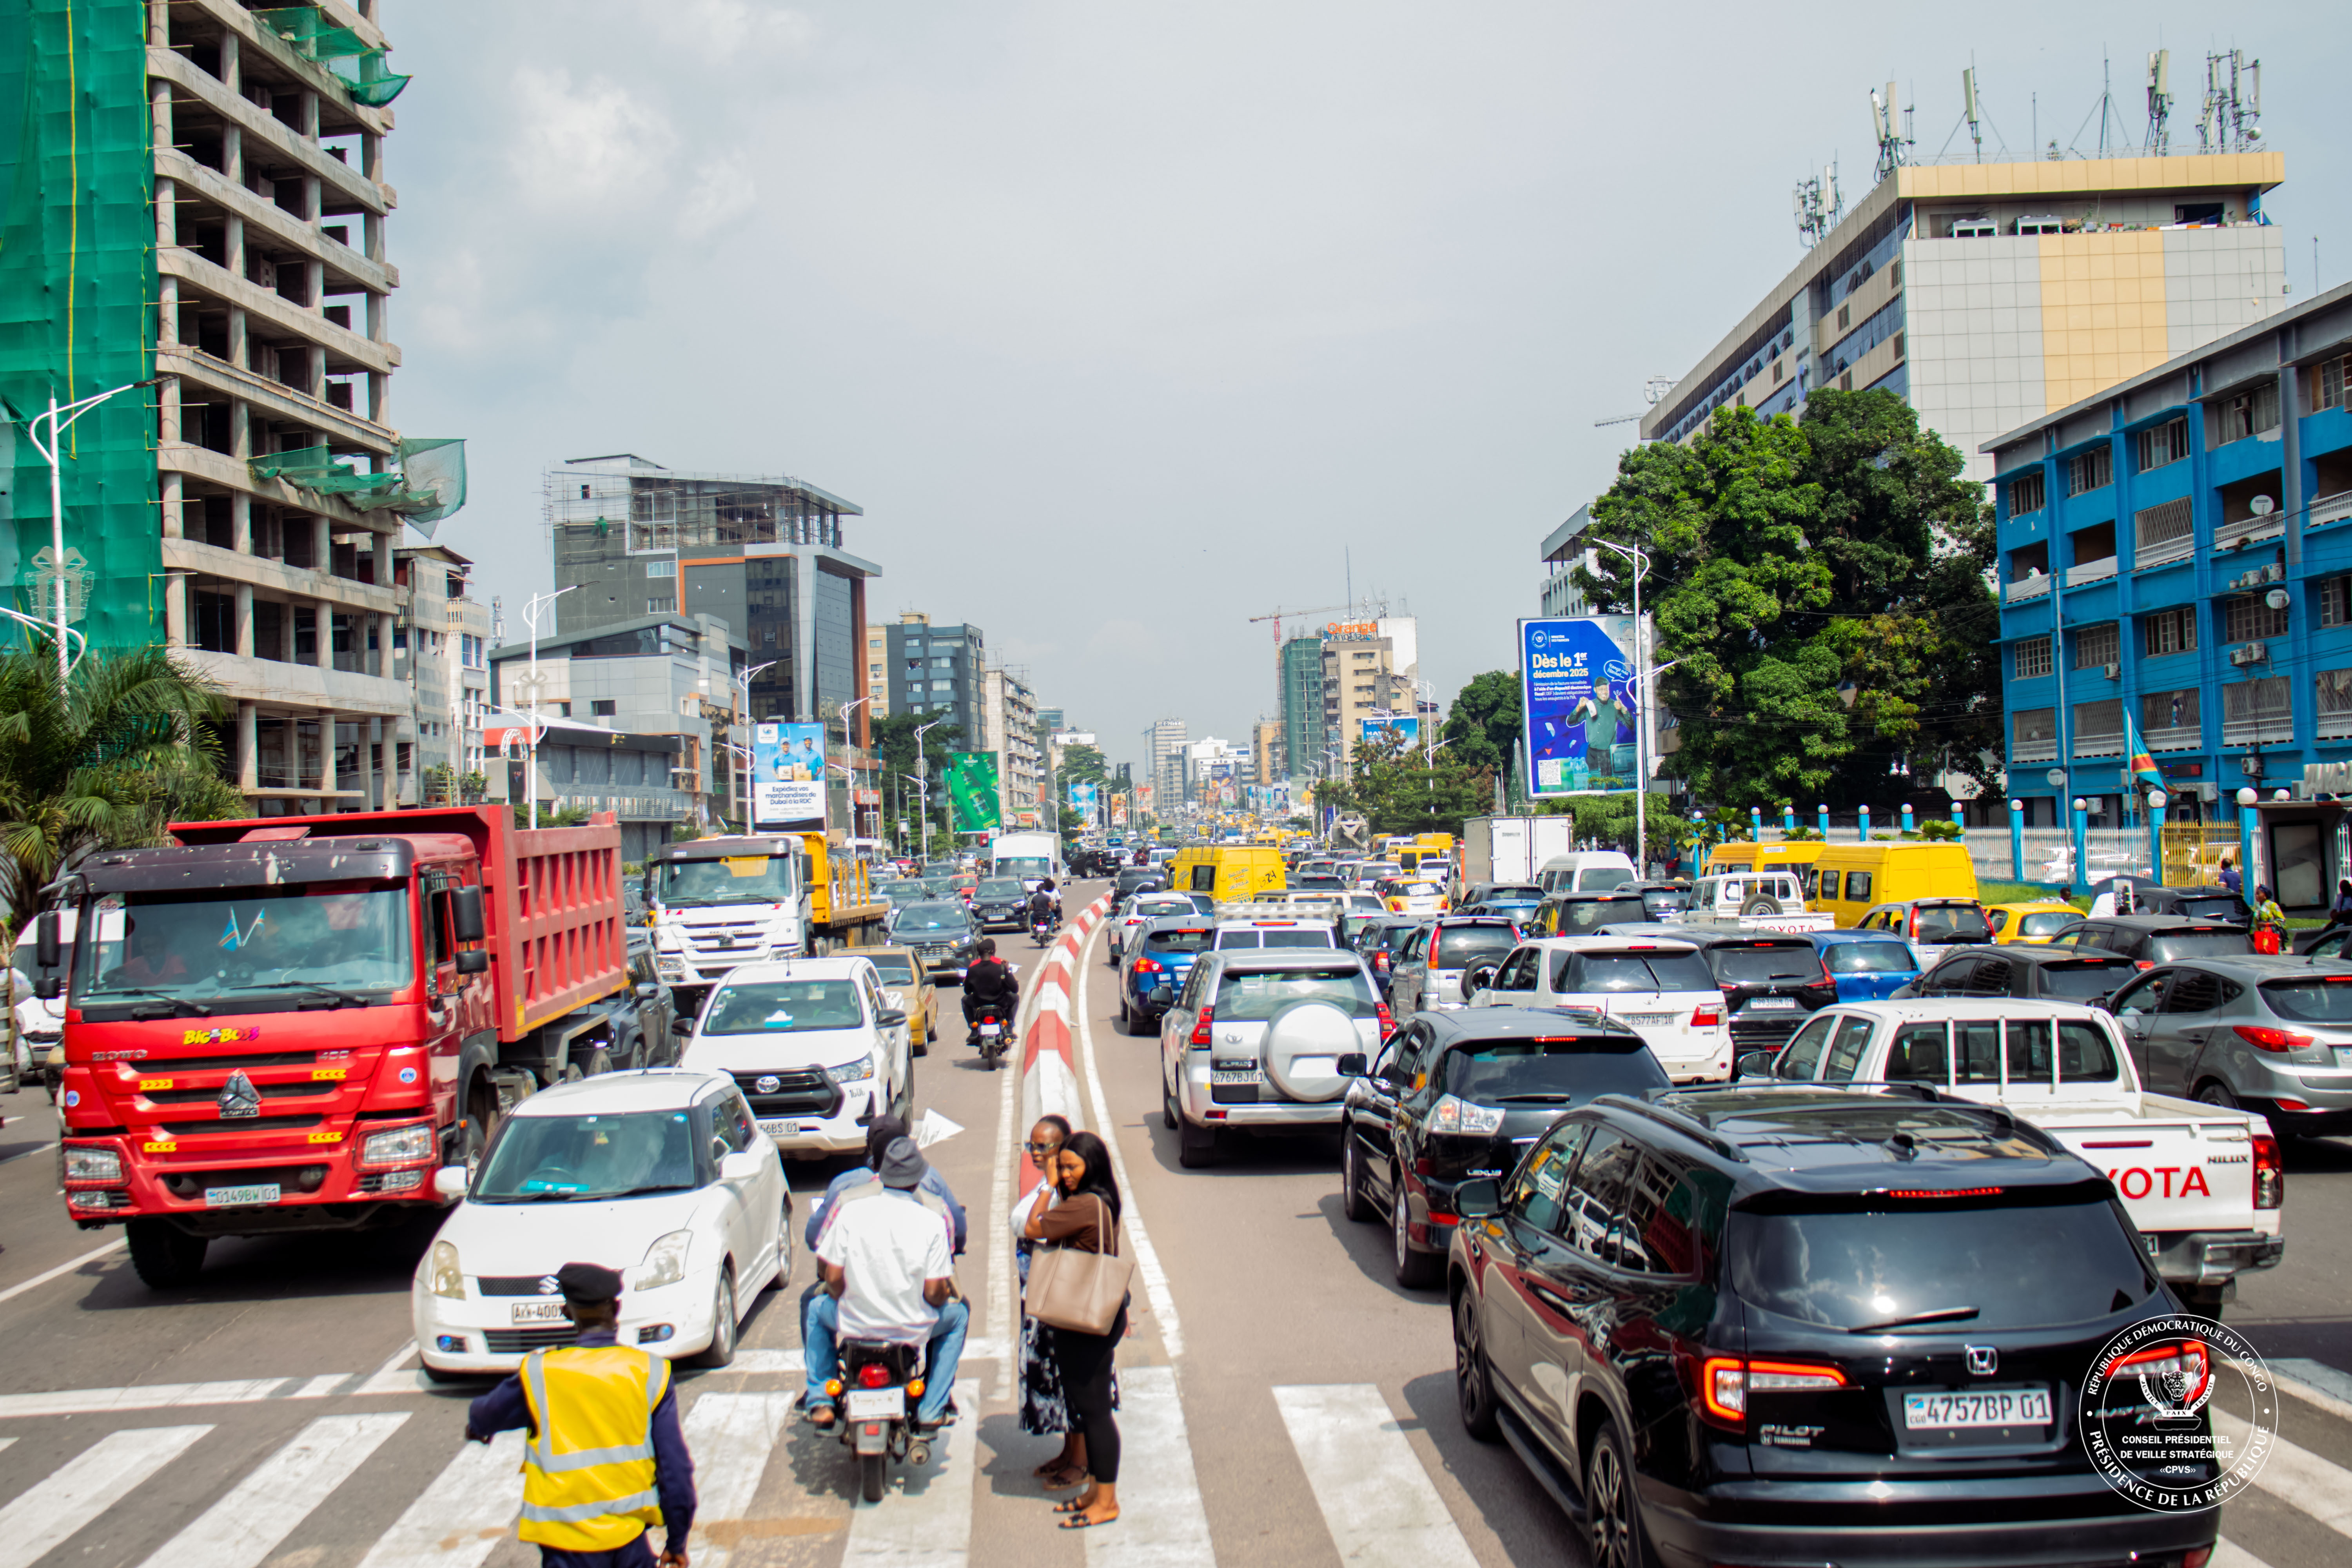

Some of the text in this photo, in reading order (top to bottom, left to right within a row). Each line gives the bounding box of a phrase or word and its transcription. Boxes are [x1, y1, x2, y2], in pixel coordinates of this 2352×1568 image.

[1328, 622, 1377, 635] Orange
[1532, 652, 1587, 668] Dès le 1er
[1533, 668, 1588, 678] décembre 2025
[1631, 1014, 1673, 1025] 8577AF 10
[92, 1049, 148, 1061] HOWO
[319, 1050, 349, 1060] 400
[1214, 1072, 1263, 1083] 6767BJ 01
[787, 1122, 797, 1132] 01
[2207, 1155, 2248, 1164] HILUX
[264, 1188, 277, 1200] 01
[1927, 1394, 2049, 1423] 4757BP 01
[1760, 1424, 1825, 1437] PILOT
